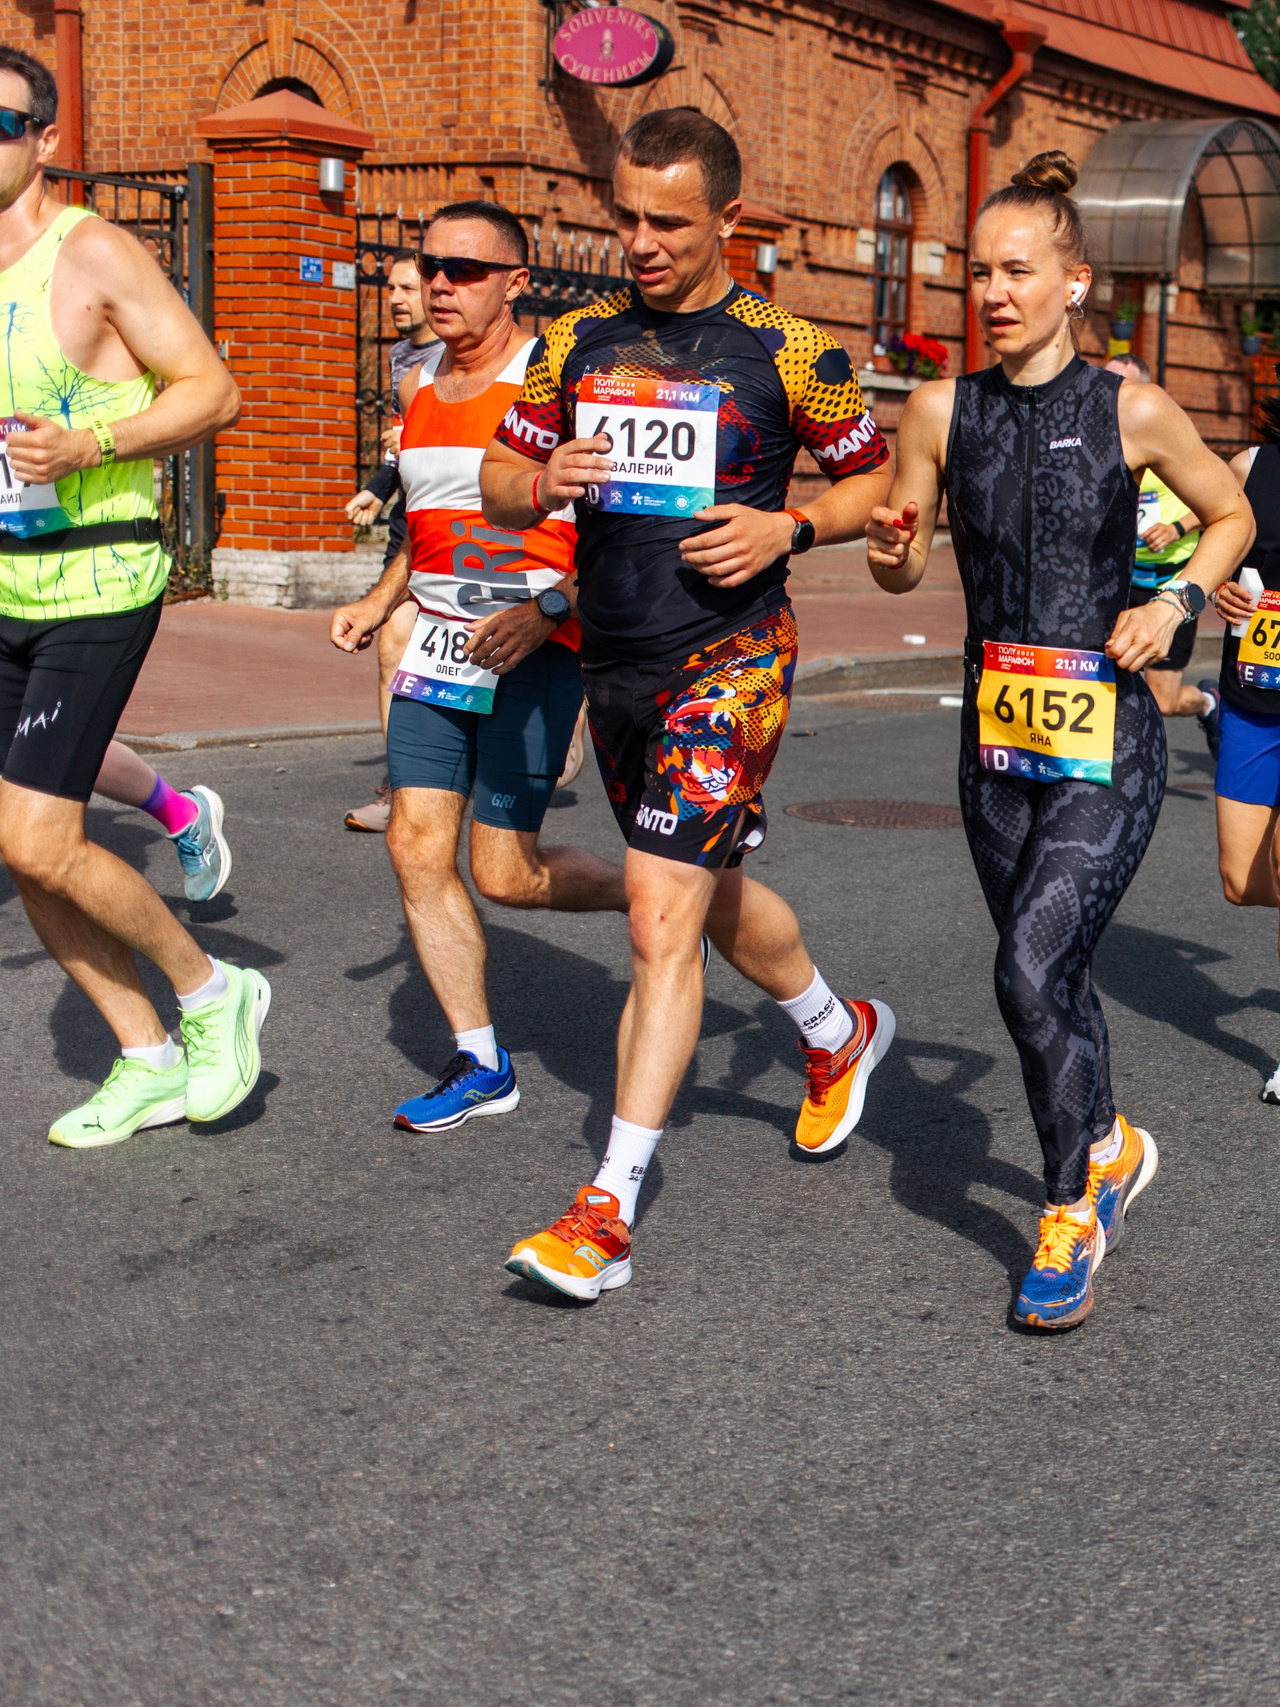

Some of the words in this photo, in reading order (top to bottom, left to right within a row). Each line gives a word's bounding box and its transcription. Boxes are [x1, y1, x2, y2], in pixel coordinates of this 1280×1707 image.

[559, 8, 654, 42] SOUVENIRS
[559, 51, 653, 83] СУВЕНИРЫ
[593, 378, 616, 388] ПОЛУ
[593, 386, 636, 397] МАРАФОН
[656, 389, 677, 401] 21,1
[592, 415, 696, 462] 6120
[1049, 437, 1082, 450] BARKA
[420, 625, 470, 664] 418
[998, 646, 1016, 655] ПОЛУ
[998, 654, 1035, 667] МАРАФОН
[1055, 658, 1077, 670] 21,1
[436, 663, 461, 677] ОЛЕГ
[1244, 665, 1255, 681] E
[400, 675, 417, 693] E
[994, 684, 1095, 734] 6152
[1030, 732, 1052, 747] ЯНА
[993, 749, 1009, 771] D
